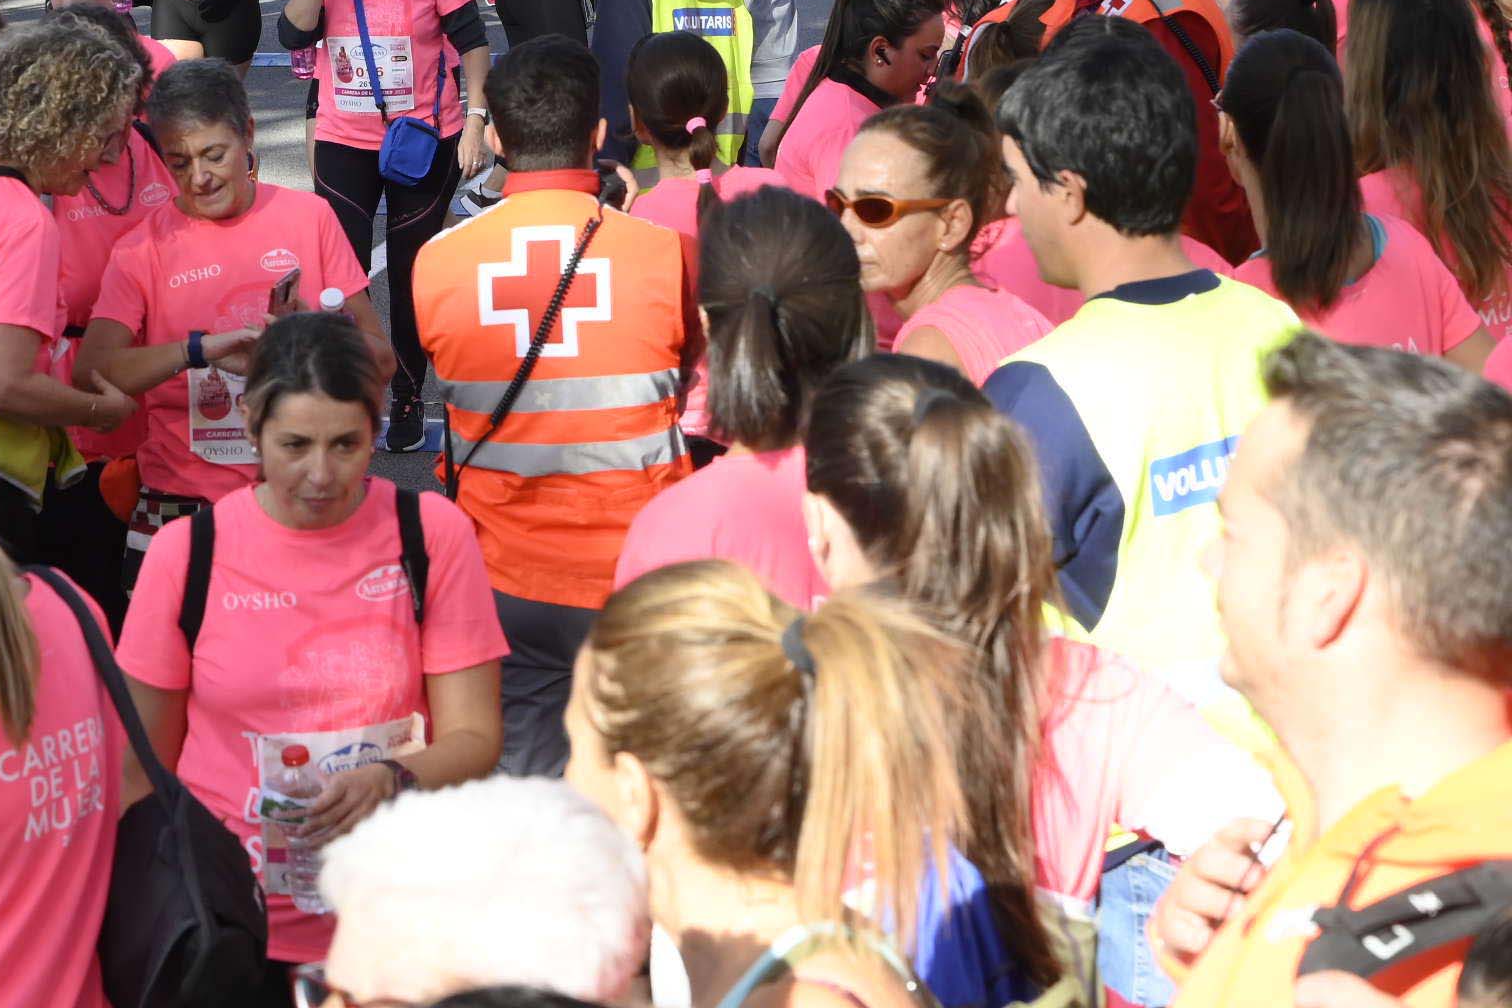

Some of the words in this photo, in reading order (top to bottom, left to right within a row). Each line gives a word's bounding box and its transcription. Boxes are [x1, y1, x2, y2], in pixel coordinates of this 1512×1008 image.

[168, 263, 223, 289] OYSHO
[203, 446, 244, 457] OYSHO
[222, 592, 298, 611] OYSHO
[30, 765, 65, 807] DE
[74, 753, 101, 790] LA
[24, 784, 105, 844] MUER
